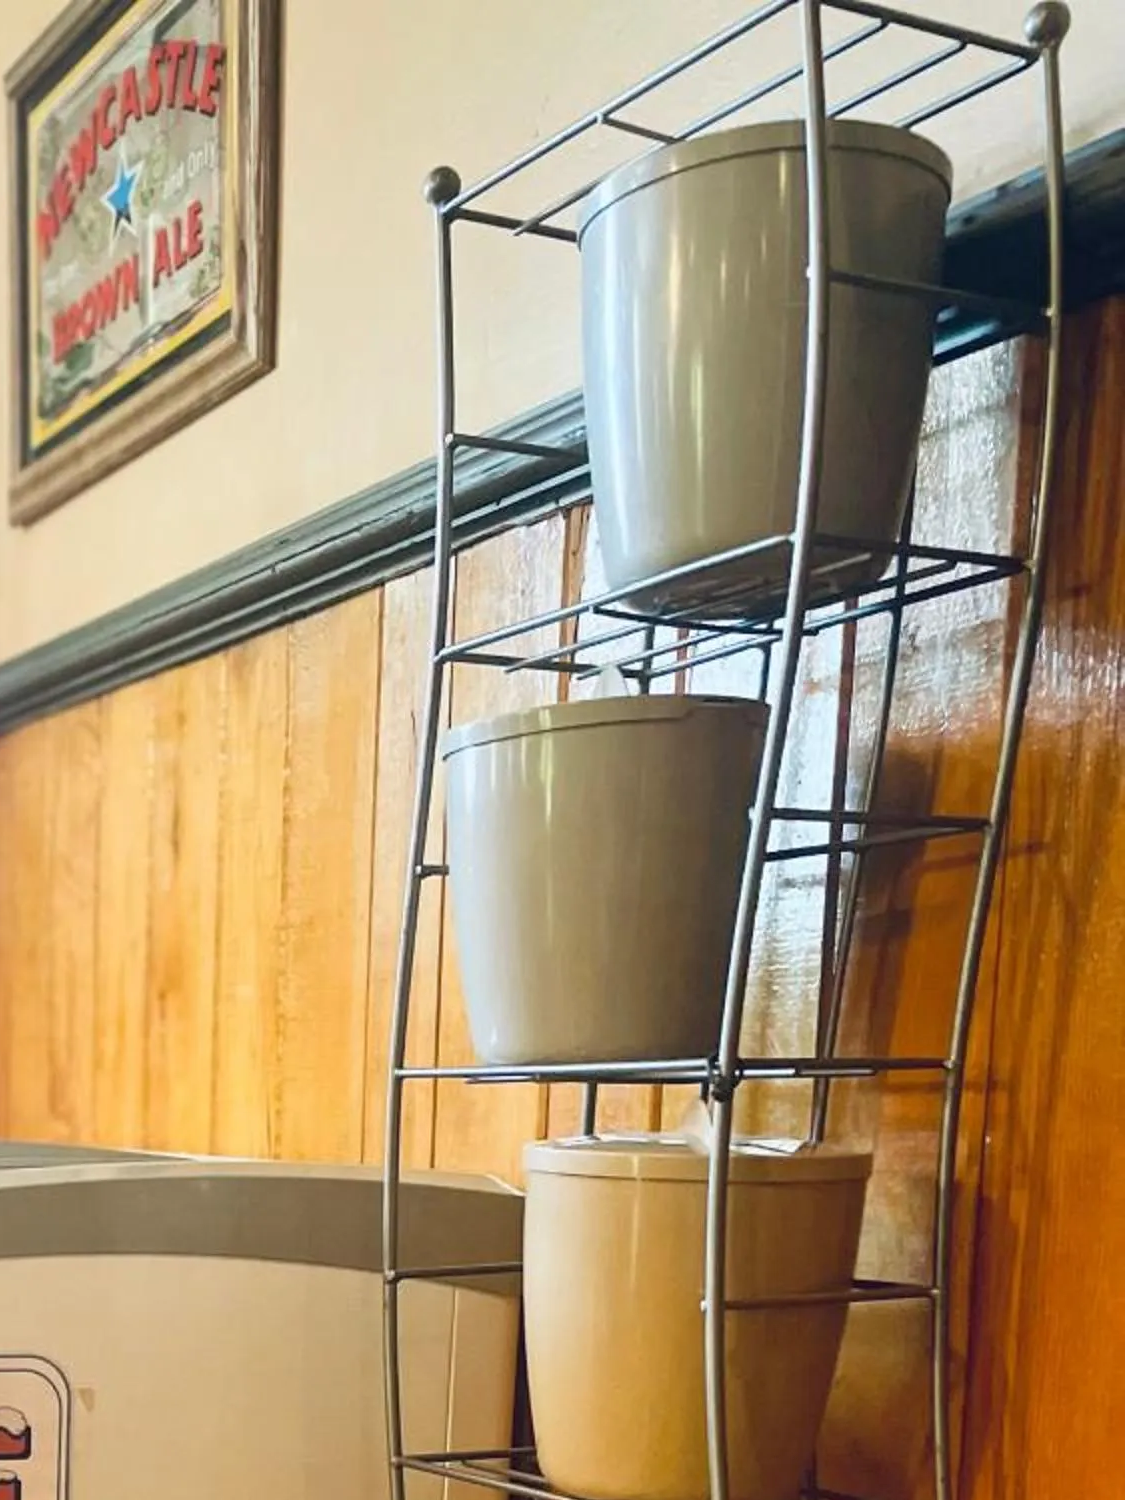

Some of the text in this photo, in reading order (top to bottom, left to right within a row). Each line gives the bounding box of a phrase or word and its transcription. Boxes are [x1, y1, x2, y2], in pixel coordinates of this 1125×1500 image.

[37, 39, 226, 260] NEWCASTLE
[52, 252, 140, 366] BROWN
[153, 199, 205, 289] ALE
